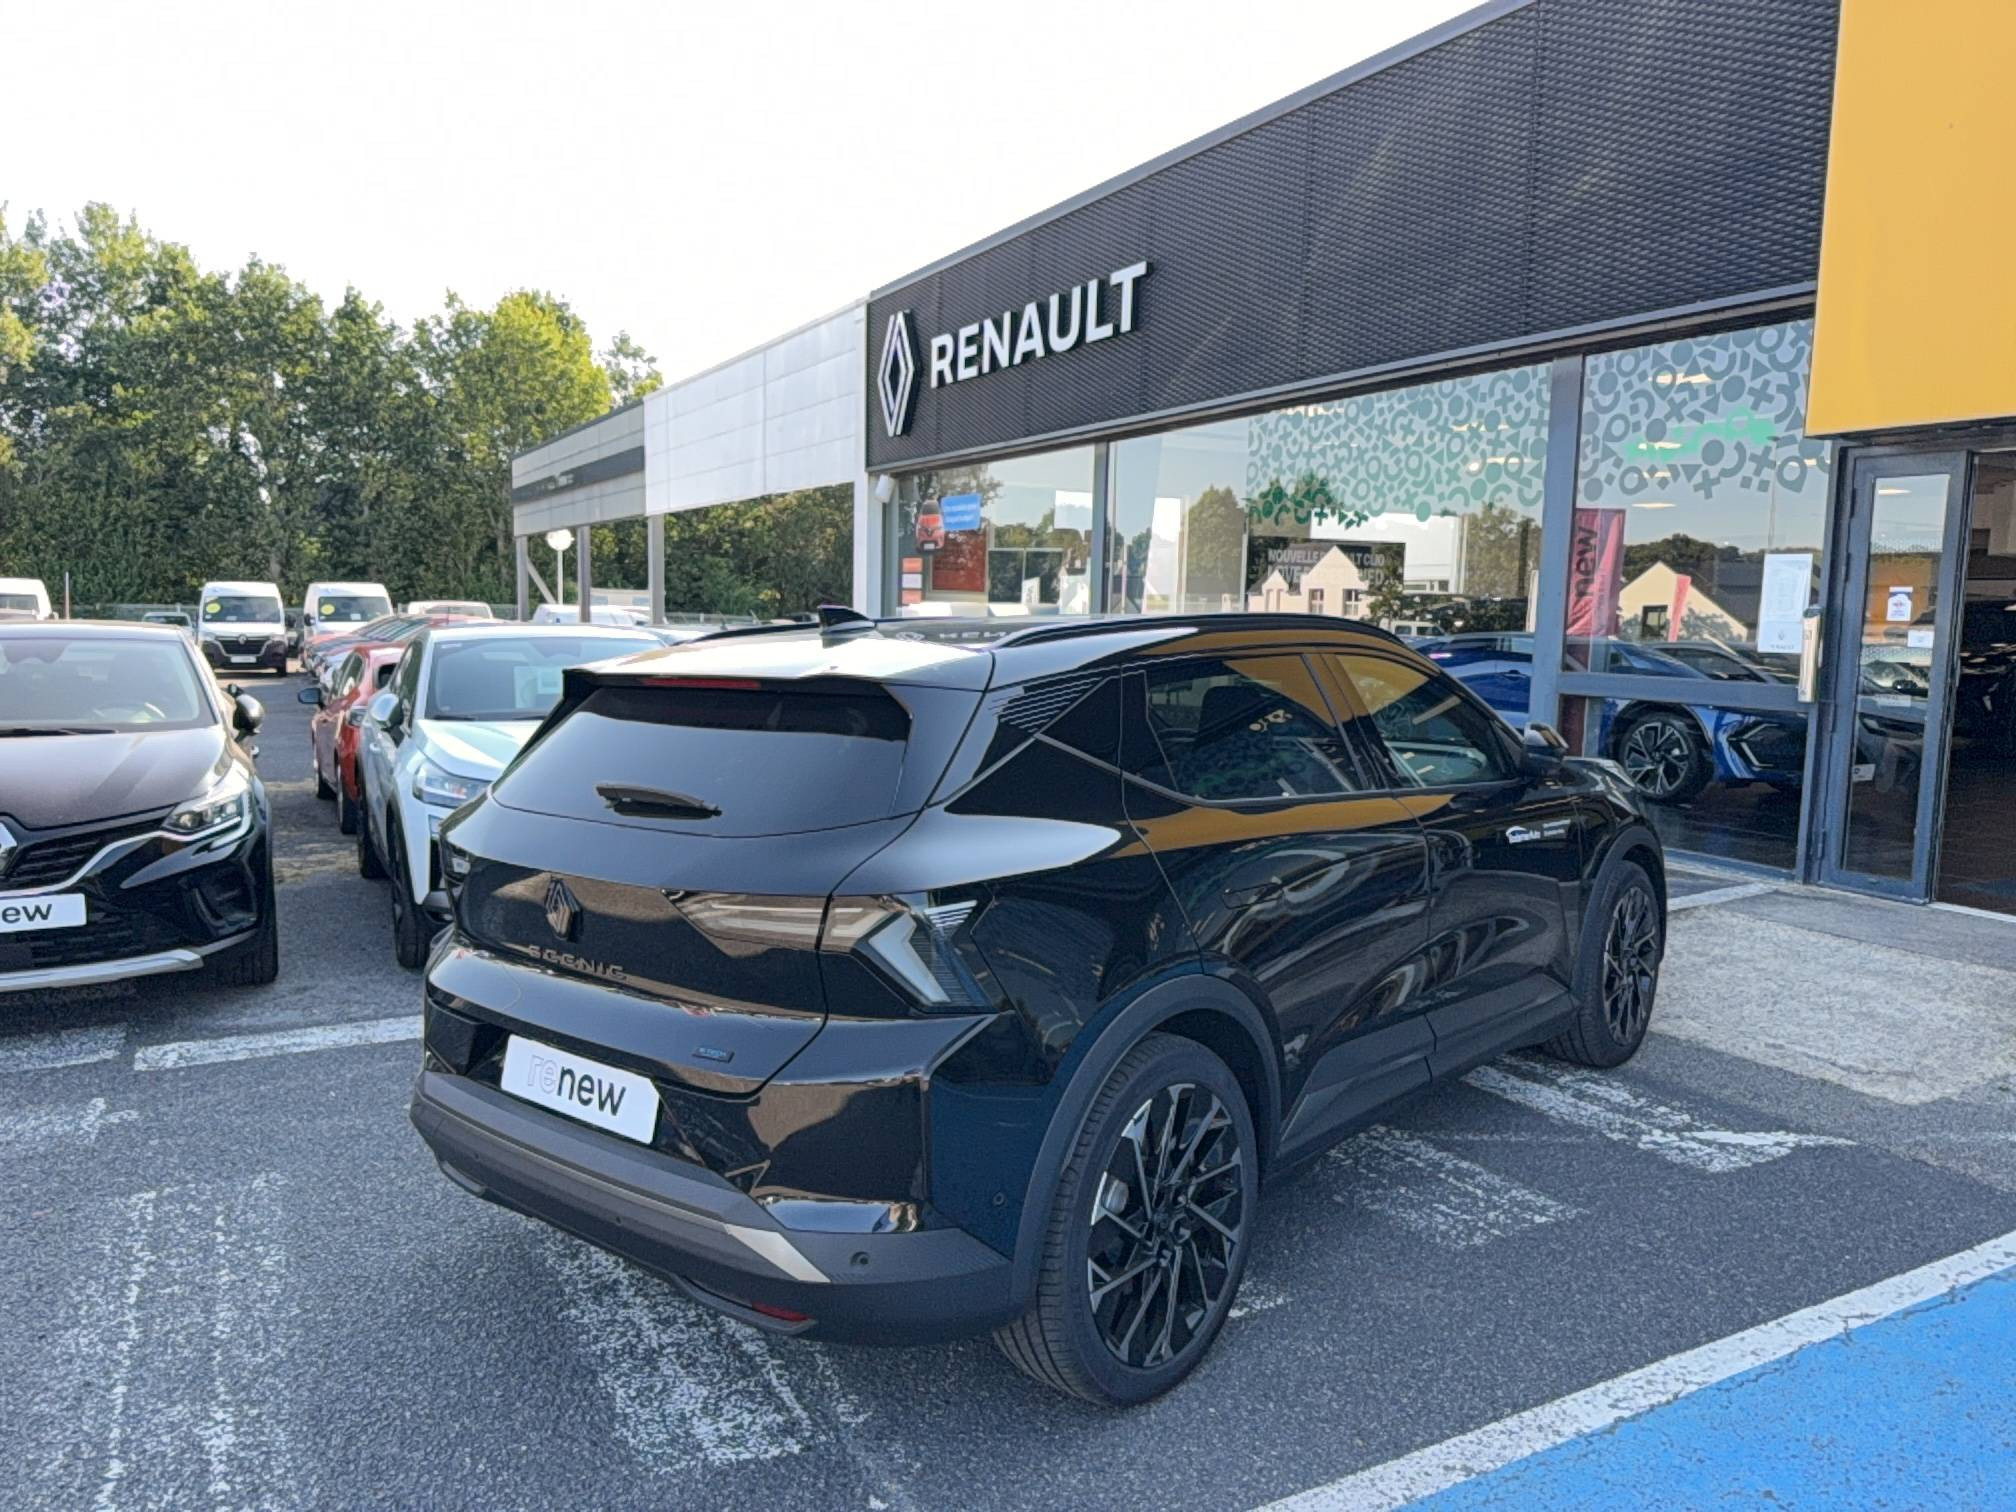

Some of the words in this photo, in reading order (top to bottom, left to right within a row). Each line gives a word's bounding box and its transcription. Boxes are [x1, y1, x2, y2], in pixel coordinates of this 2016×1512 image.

[931, 261, 1147, 388] RENAULT
[1268, 548, 1319, 564] NOUVELLE
[528, 944, 626, 981] SCENIC
[527, 1054, 627, 1116] renew
